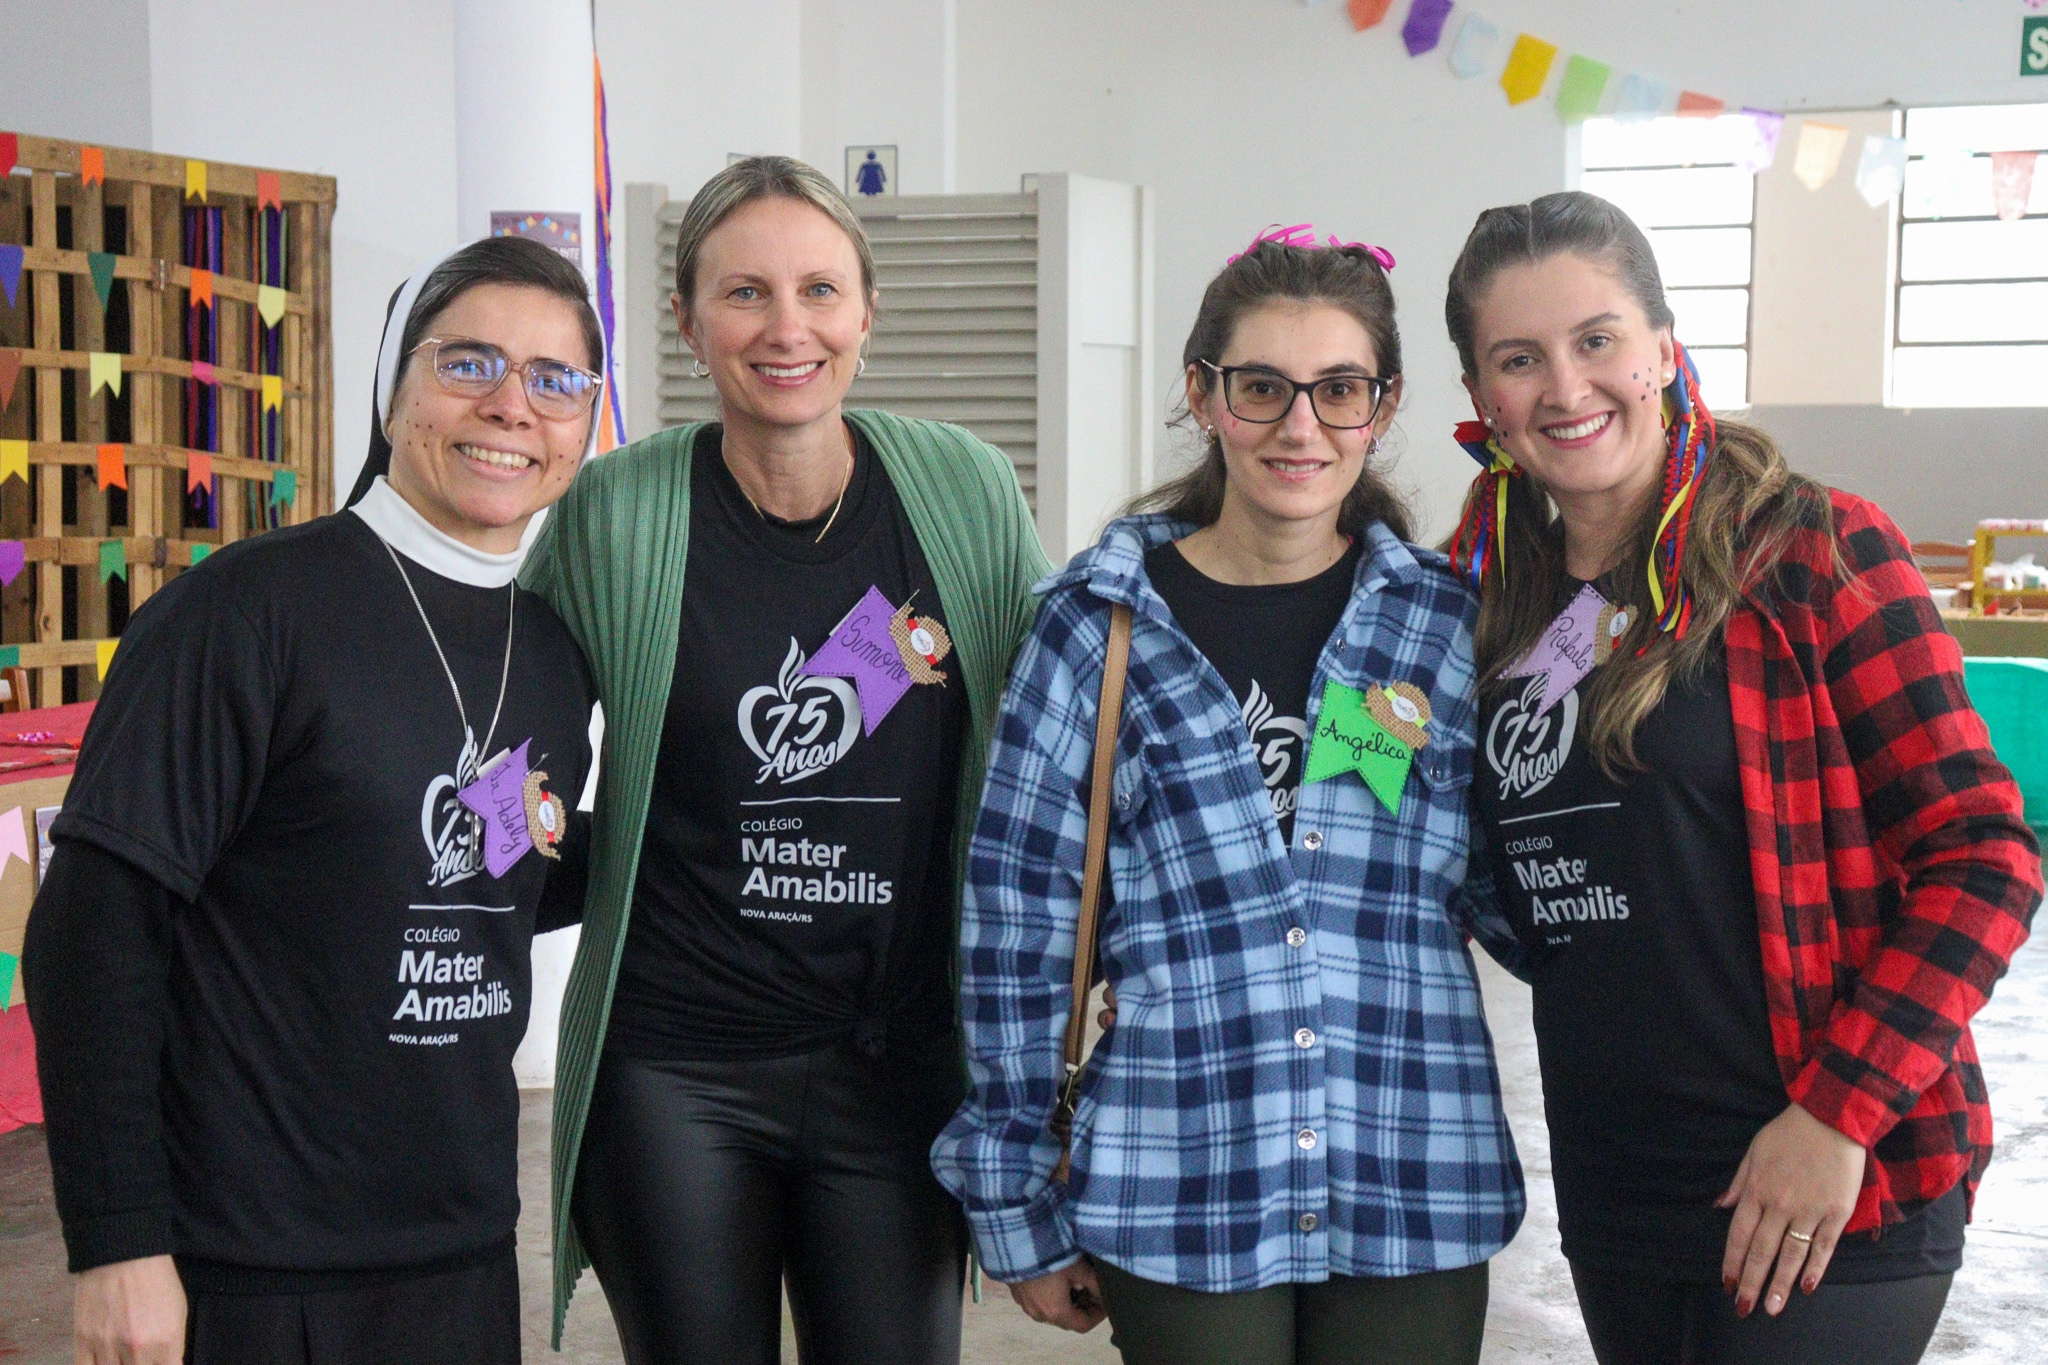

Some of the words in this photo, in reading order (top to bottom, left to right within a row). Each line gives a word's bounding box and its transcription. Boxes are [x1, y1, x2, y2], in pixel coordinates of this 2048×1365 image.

[1550, 616, 1593, 671] Rafaela
[765, 694, 832, 754] 75
[1320, 719, 1408, 761] Angélica
[754, 741, 837, 784] Anos
[1252, 736, 1295, 786] 5
[1499, 748, 1558, 800] Anos
[493, 796, 528, 854] Adely
[741, 817, 803, 832] COLÉGIO
[741, 837, 847, 868] Mater
[1505, 835, 1553, 855] COLÉGIO
[741, 866, 893, 904] Amabilis
[1513, 856, 1587, 891] Mate
[404, 926, 460, 943] COLÉGIO
[740, 908, 766, 918] NOVA
[768, 911, 813, 923] ARAÇÁ/RS
[398, 950, 485, 984] Mater
[392, 981, 512, 1022] Amabilis
[388, 1033, 418, 1045] NOVA
